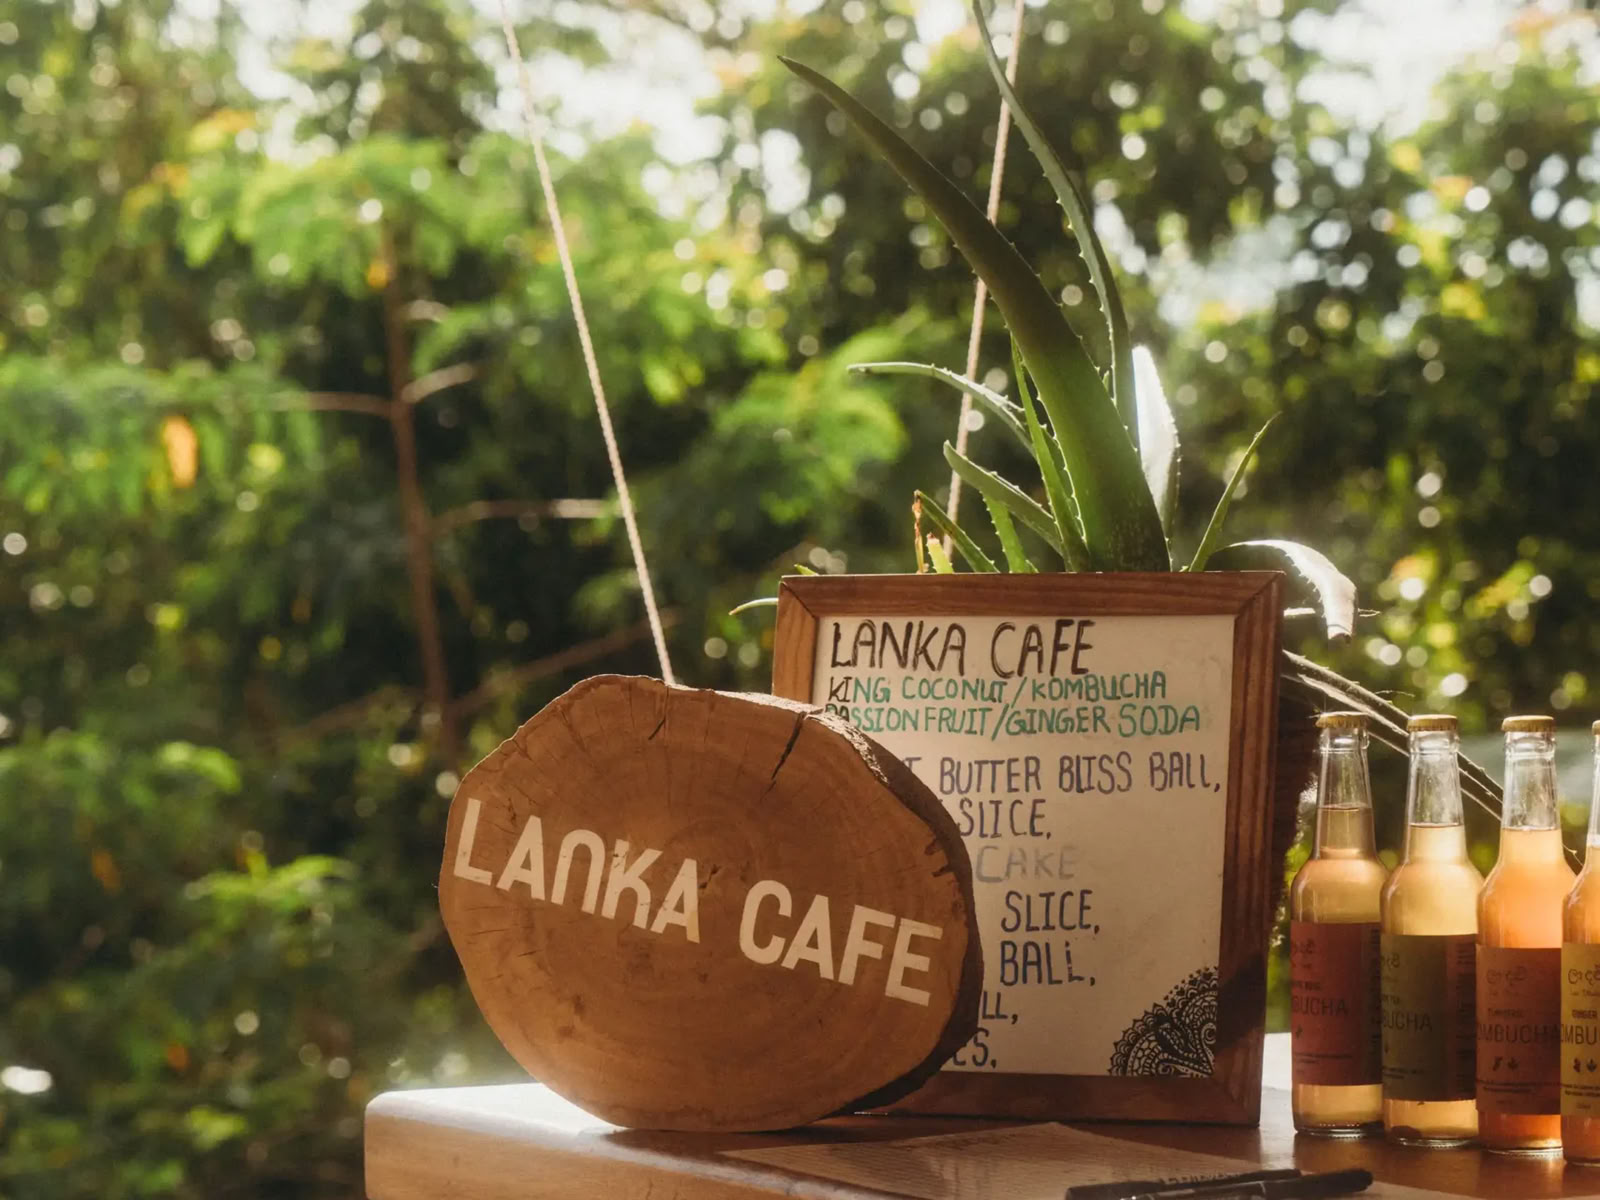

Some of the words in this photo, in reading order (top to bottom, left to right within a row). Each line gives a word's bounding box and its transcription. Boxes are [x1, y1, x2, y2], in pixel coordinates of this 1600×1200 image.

[830, 619, 966, 673] LANKA
[990, 619, 1097, 679] CAFE
[828, 676, 892, 703] KING
[1118, 703, 1200, 738] SODA
[939, 756, 1042, 795] BUTTER
[1059, 751, 1132, 795] BLISS
[1149, 751, 1220, 793] BALL,
[975, 846, 1078, 883] CAKE
[453, 798, 700, 944] LANKA
[739, 878, 943, 1007] CAFE
[1001, 889, 1099, 934] SLICE,
